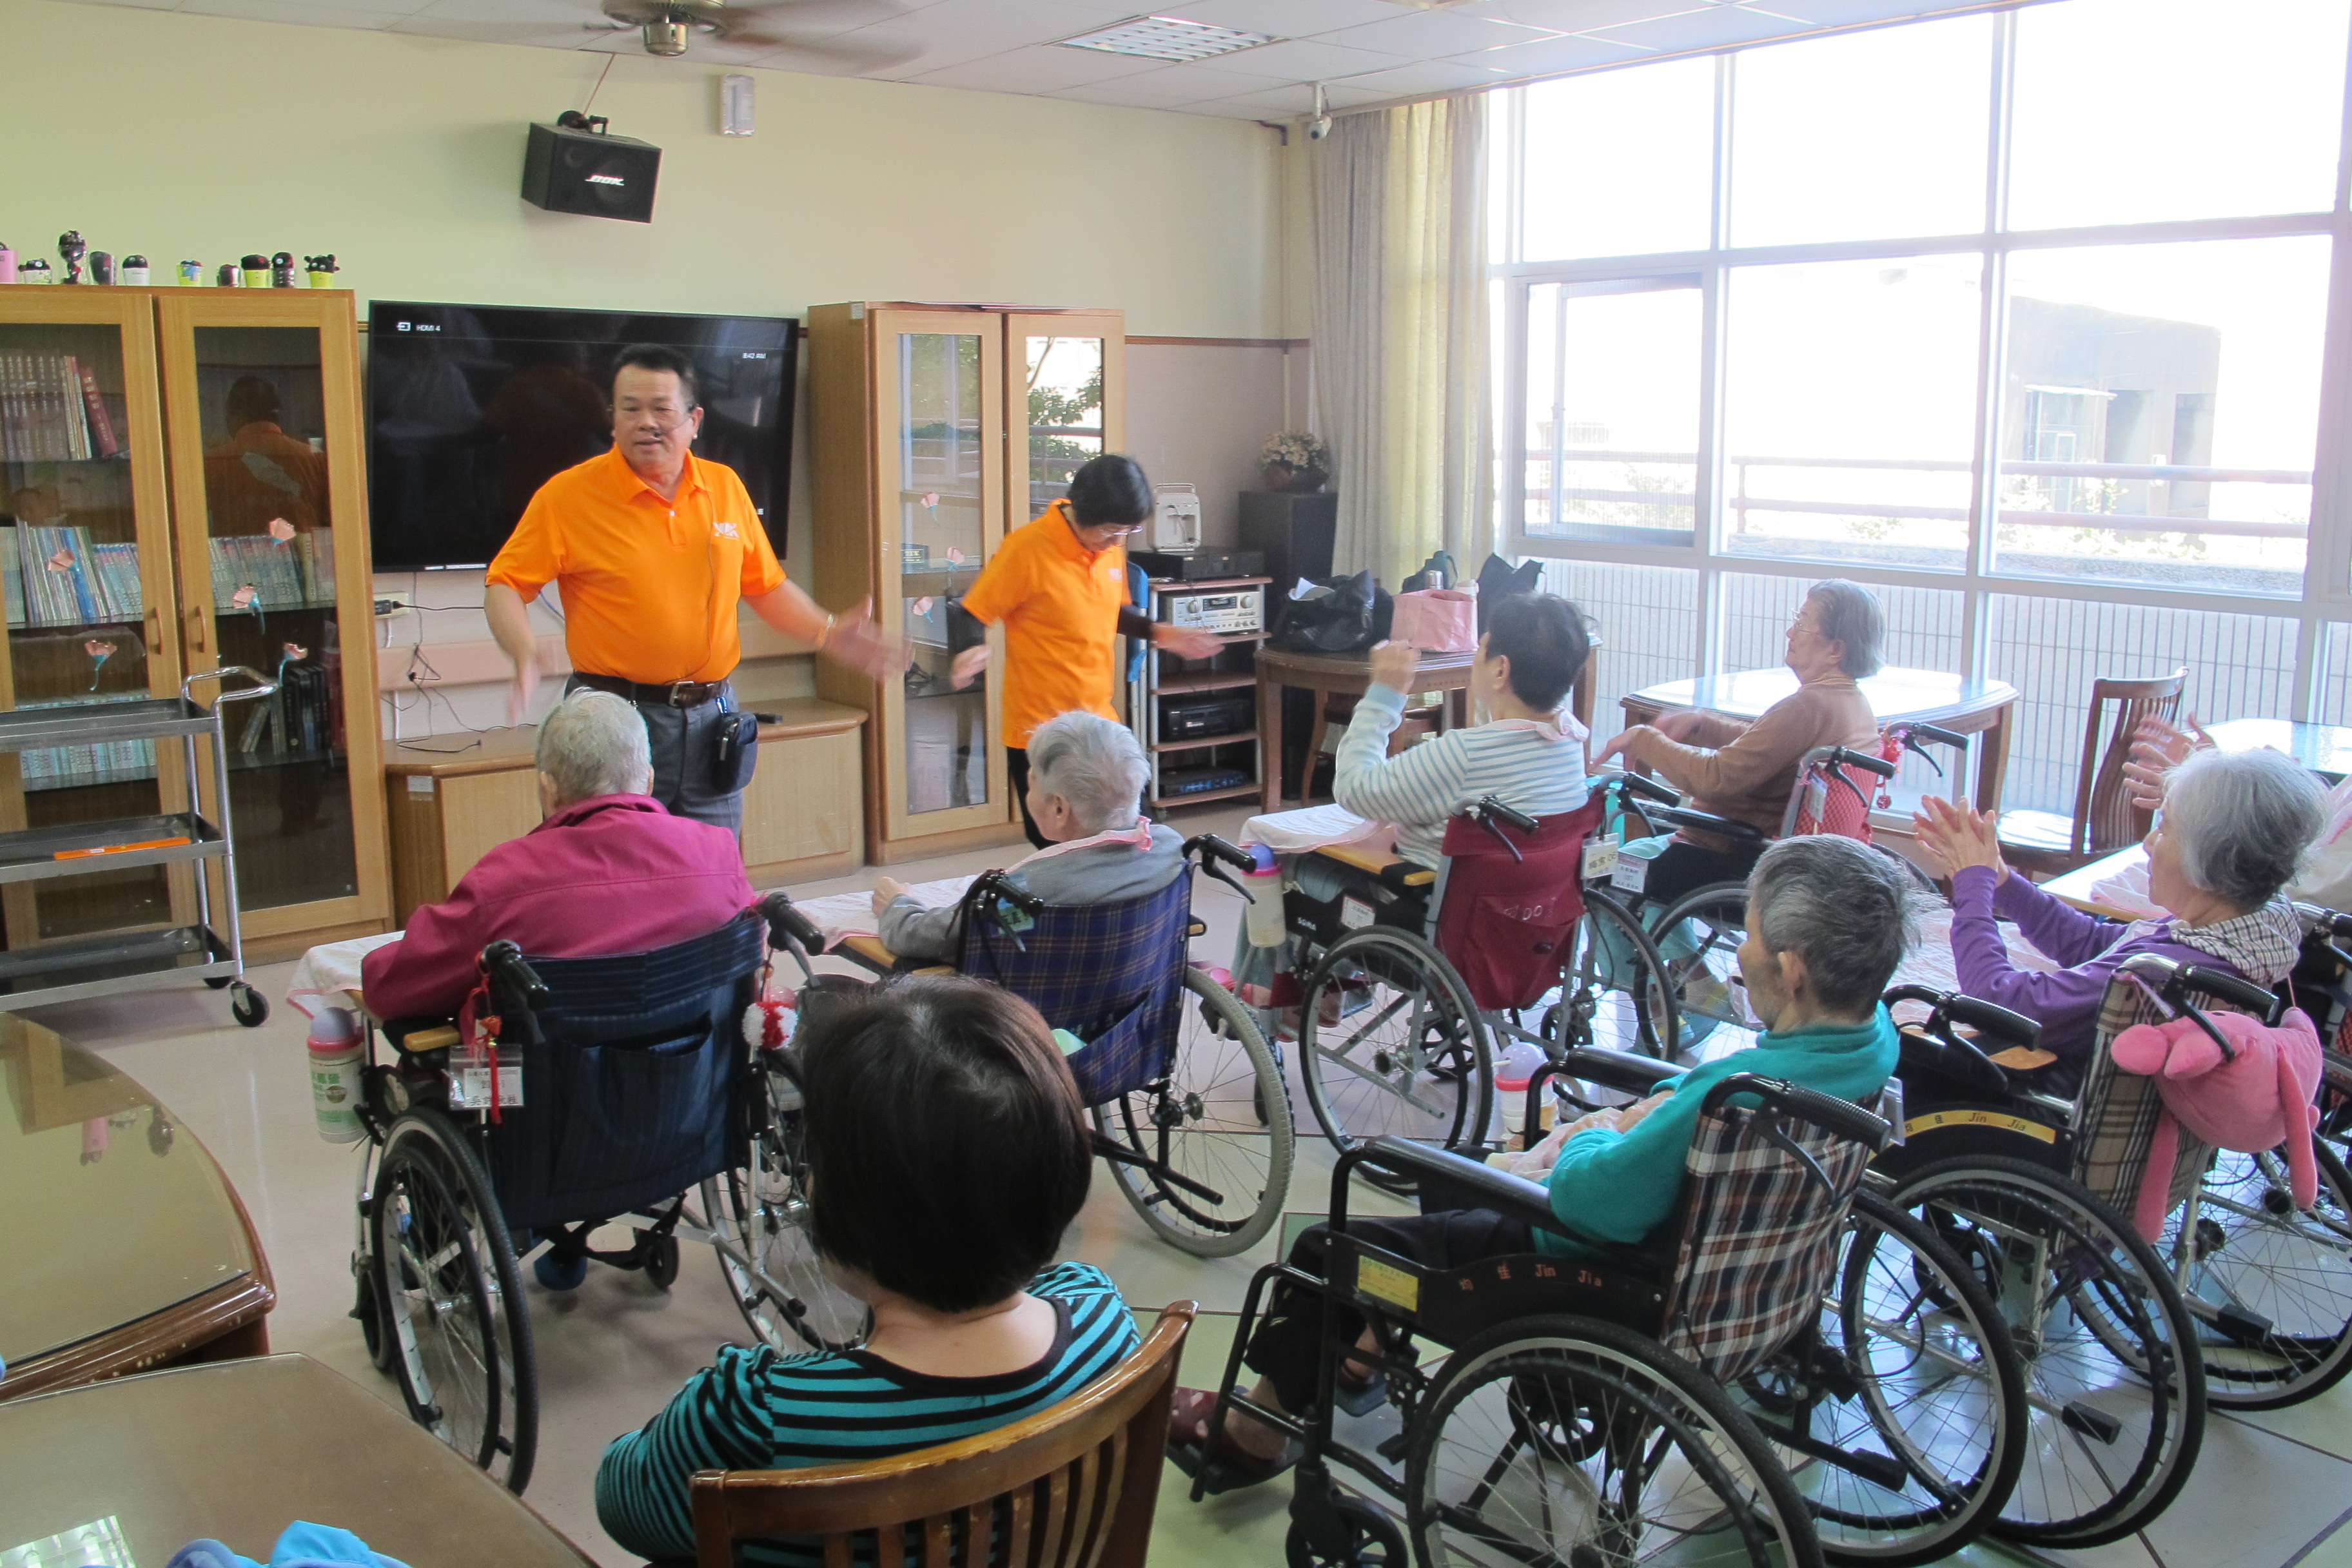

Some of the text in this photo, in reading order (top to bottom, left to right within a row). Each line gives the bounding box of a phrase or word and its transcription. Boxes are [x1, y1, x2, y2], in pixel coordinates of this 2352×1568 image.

[1968, 1112, 1987, 1123] Jin
[2007, 1119, 2026, 1132] Jia
[1536, 1264, 1556, 1277] Jin
[1578, 1269, 1602, 1287] Jia
